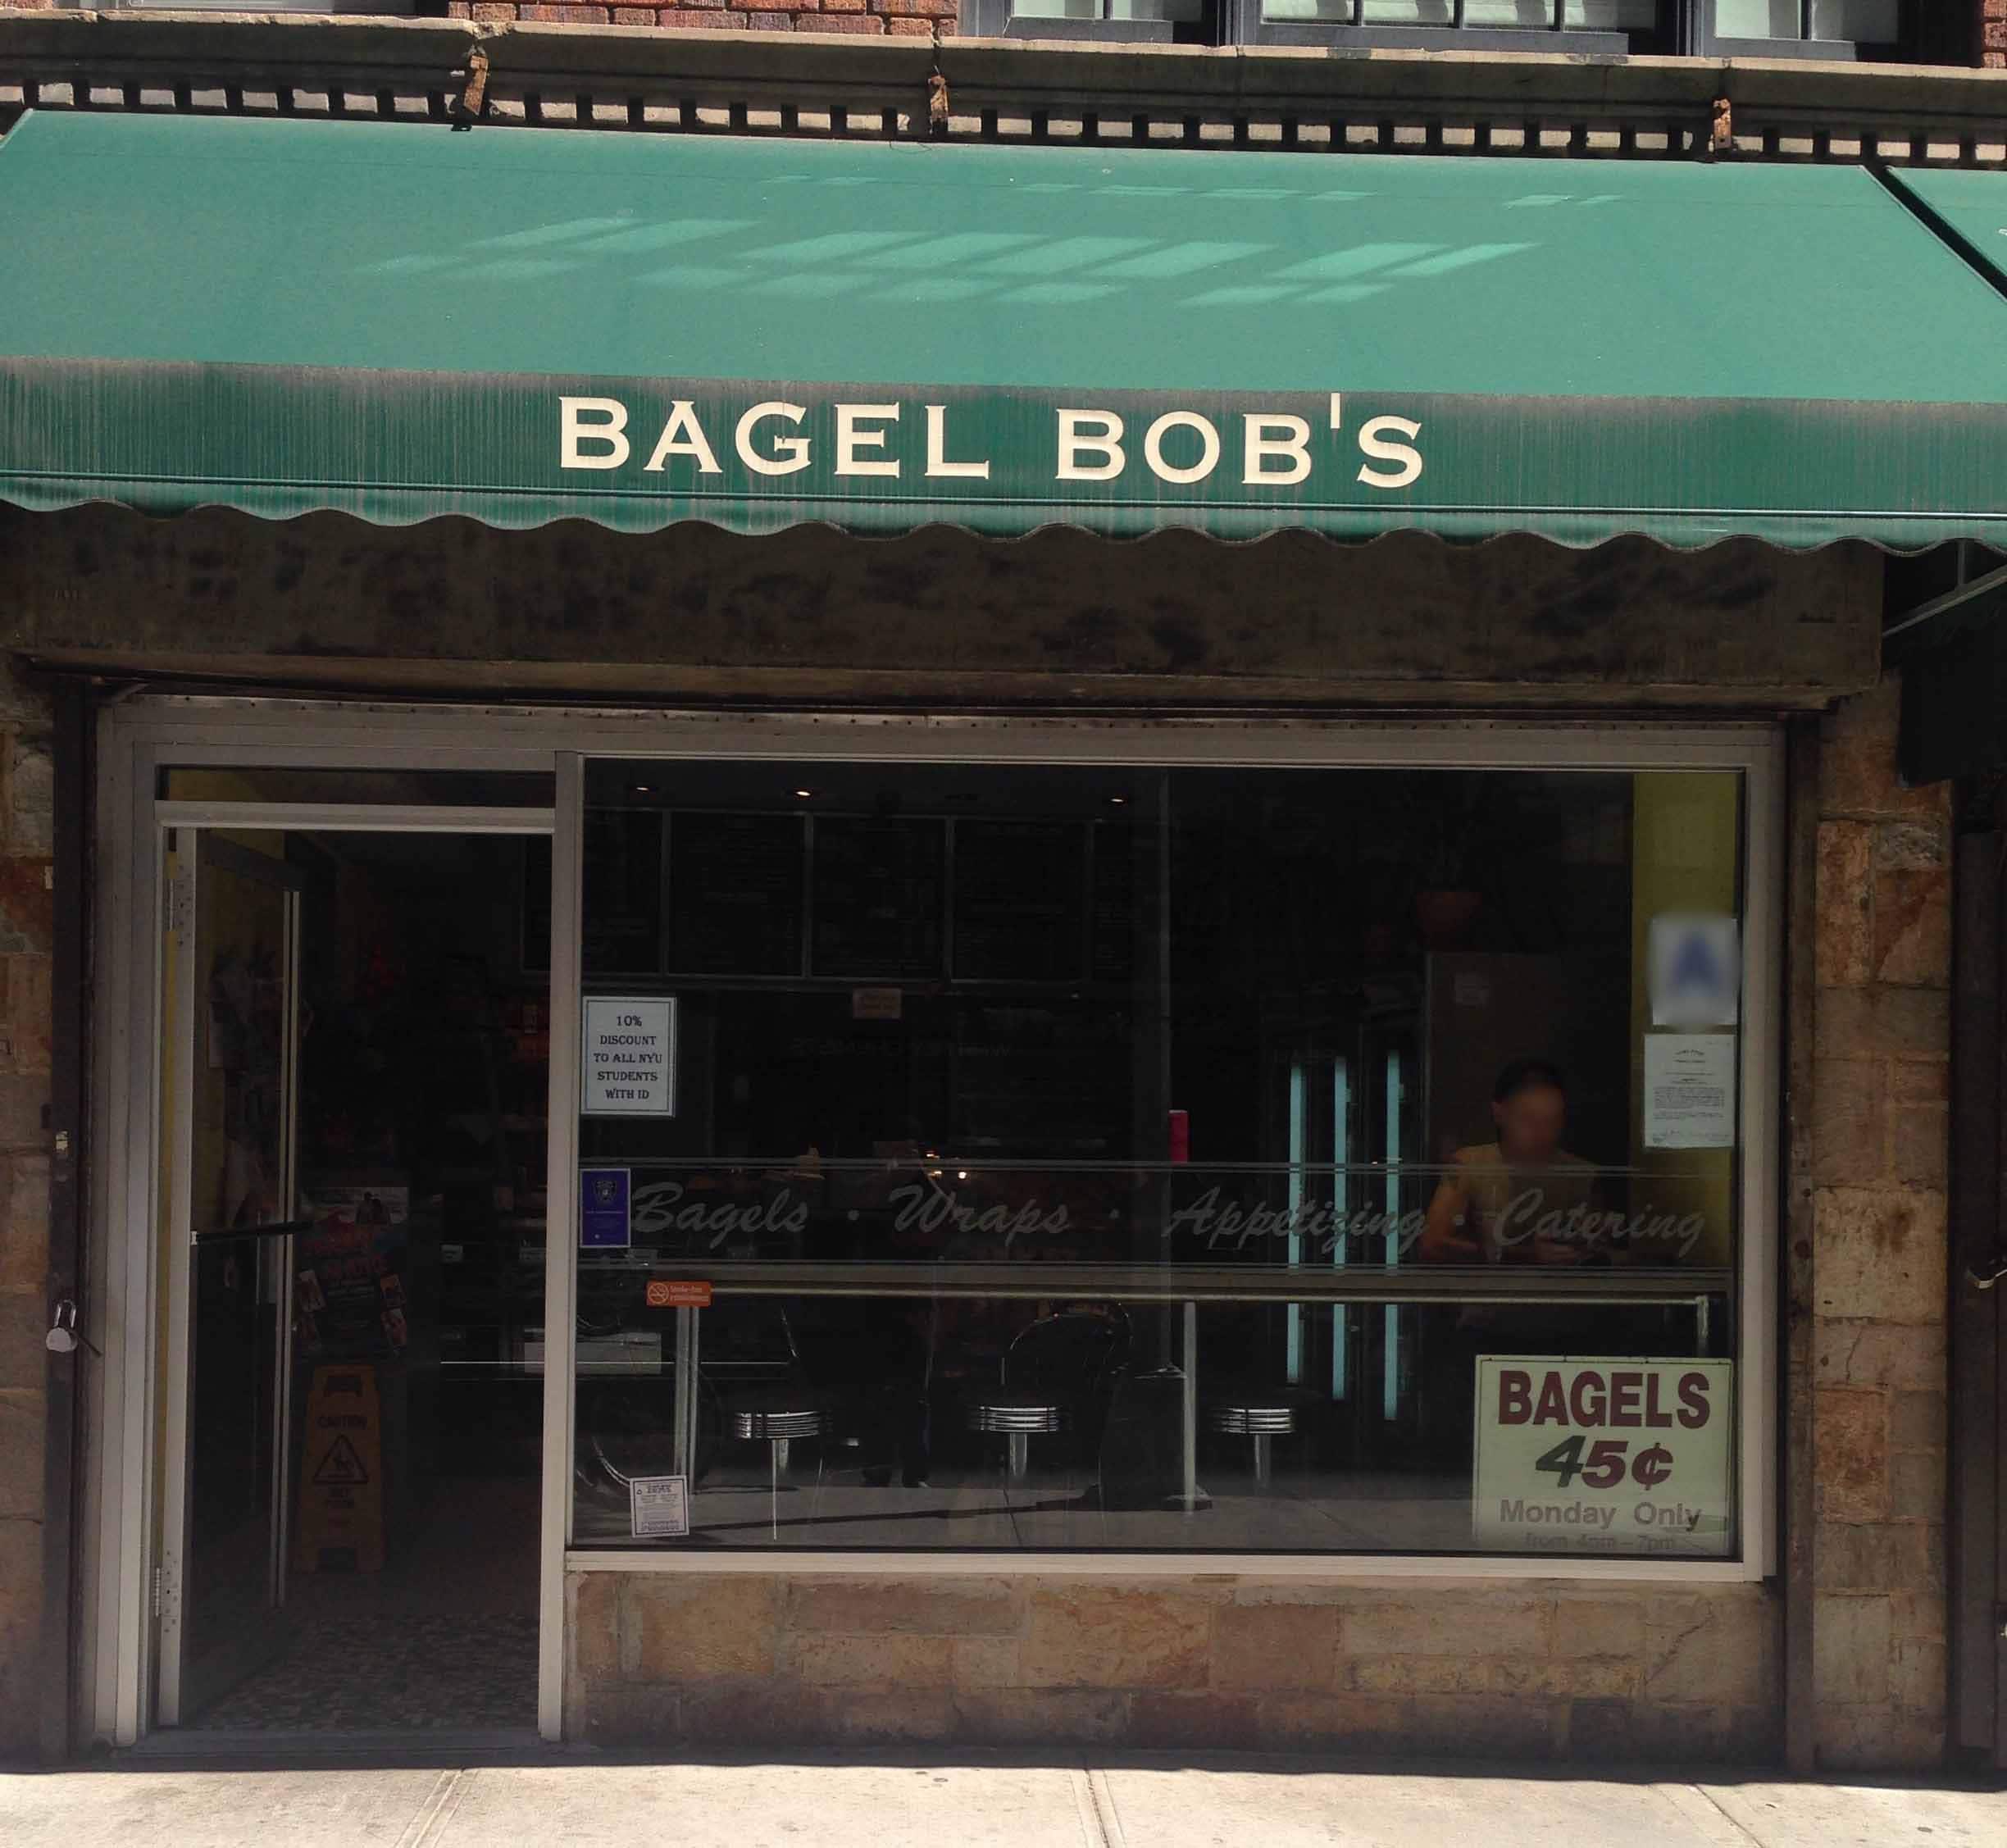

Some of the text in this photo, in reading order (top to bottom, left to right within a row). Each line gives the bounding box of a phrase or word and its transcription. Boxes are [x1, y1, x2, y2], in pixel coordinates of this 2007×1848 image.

[558, 392, 1423, 489] BAGEL BOB'S
[617, 1015, 643, 1027] 10%
[599, 1035, 657, 1045] DISCOUNT
[594, 1053, 662, 1064] TO ALL NYU
[597, 1071, 658, 1081] STUDENTS
[605, 1088, 650, 1099] WITH ID
[632, 1181, 808, 1250] Bagels
[890, 1185, 1071, 1246] Wraps
[1163, 1186, 1425, 1255] Appetizing
[1493, 1188, 1705, 1259] Catering
[1498, 1370, 1710, 1429] BAGELS
[1535, 1435, 1674, 1491] 45¢
[1500, 1500, 1703, 1532] Monday Only
